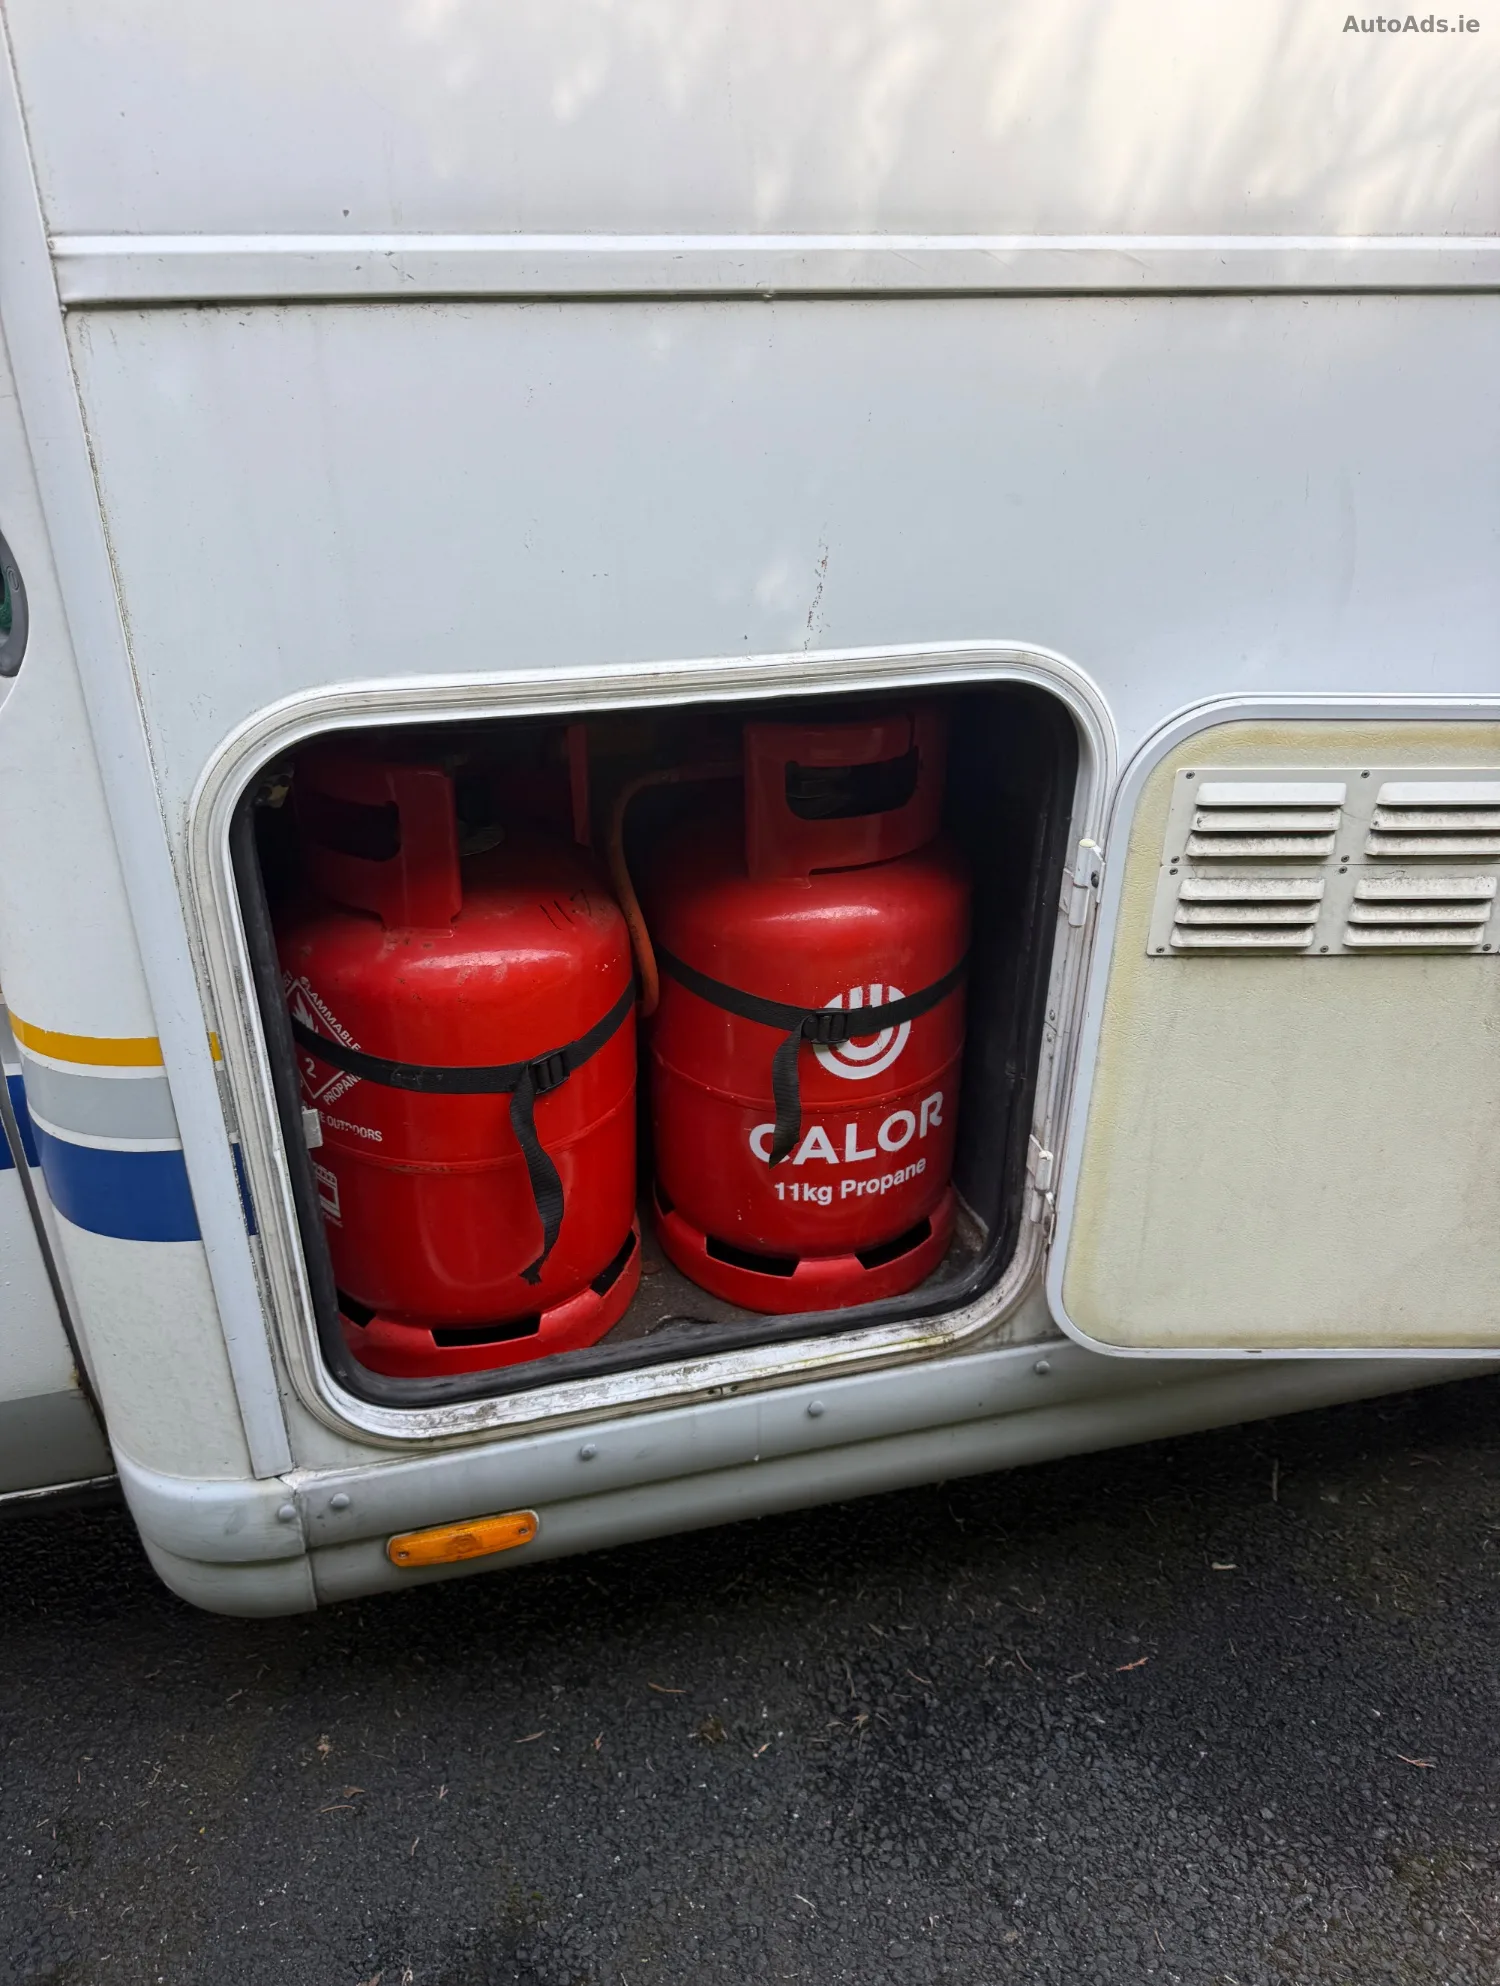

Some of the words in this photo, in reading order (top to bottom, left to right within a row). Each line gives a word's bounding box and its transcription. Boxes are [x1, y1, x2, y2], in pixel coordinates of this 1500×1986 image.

[304, 1057, 317, 1079] 2
[749, 1091, 944, 1165] CALOR
[774, 1182, 832, 1205] 11kg
[840, 1158, 926, 1199] Propane
